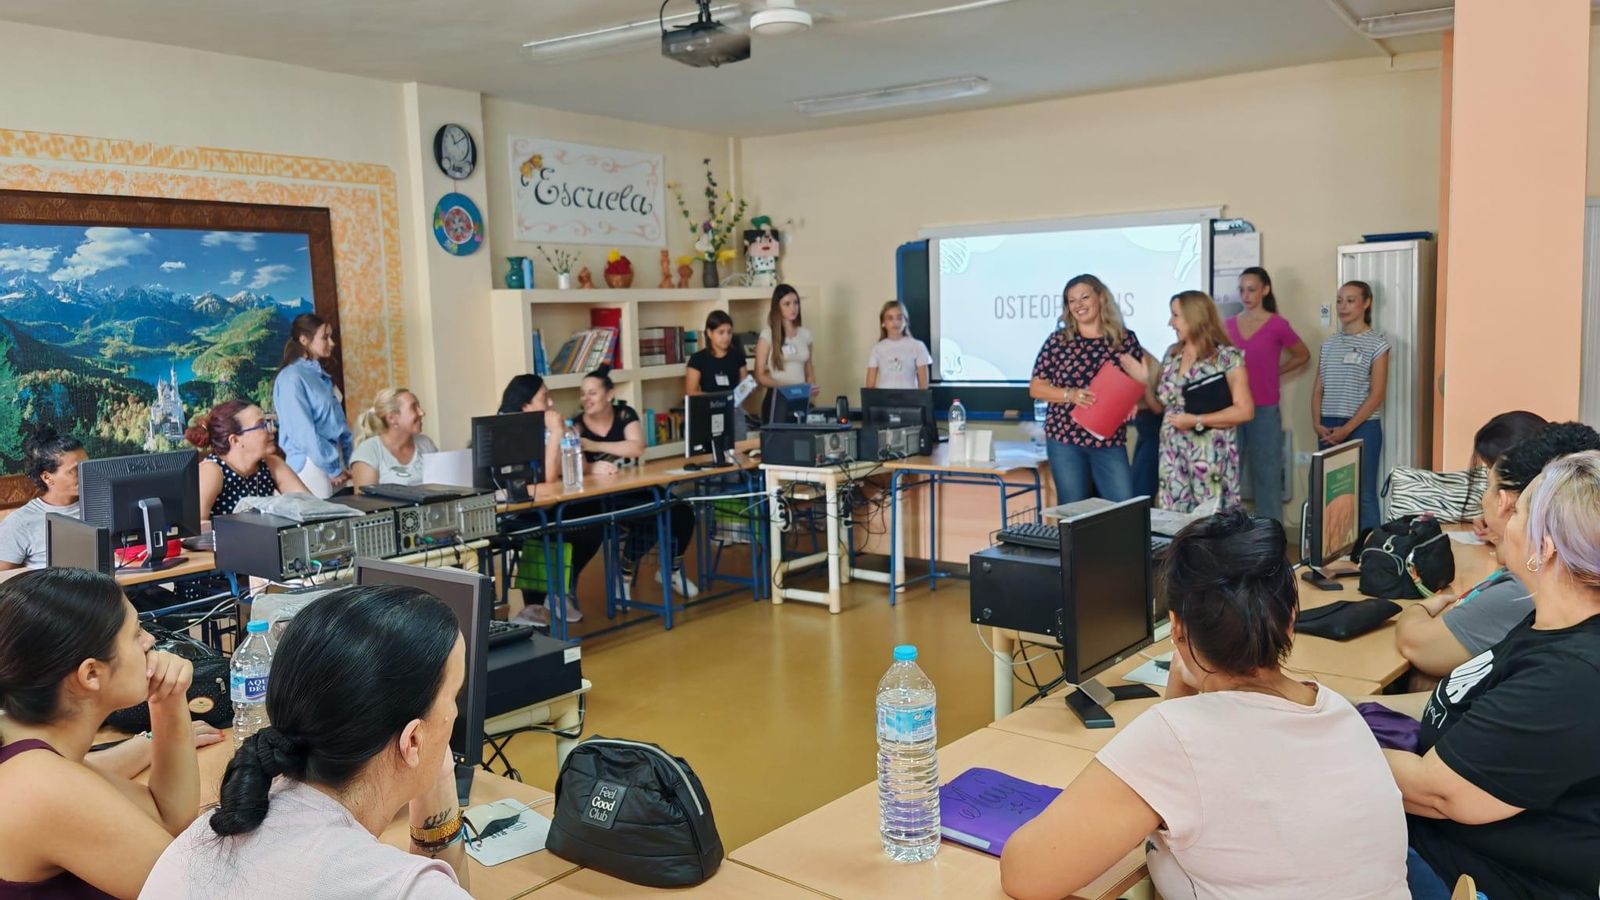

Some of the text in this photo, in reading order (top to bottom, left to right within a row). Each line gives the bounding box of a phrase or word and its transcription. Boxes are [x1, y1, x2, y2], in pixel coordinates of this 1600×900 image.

[534, 167, 653, 215] Escuela
[994, 292, 1135, 320] OSTEOPIS
[599, 786, 617, 799] Feel
[591, 796, 616, 811] Good
[589, 808, 608, 822] Club
